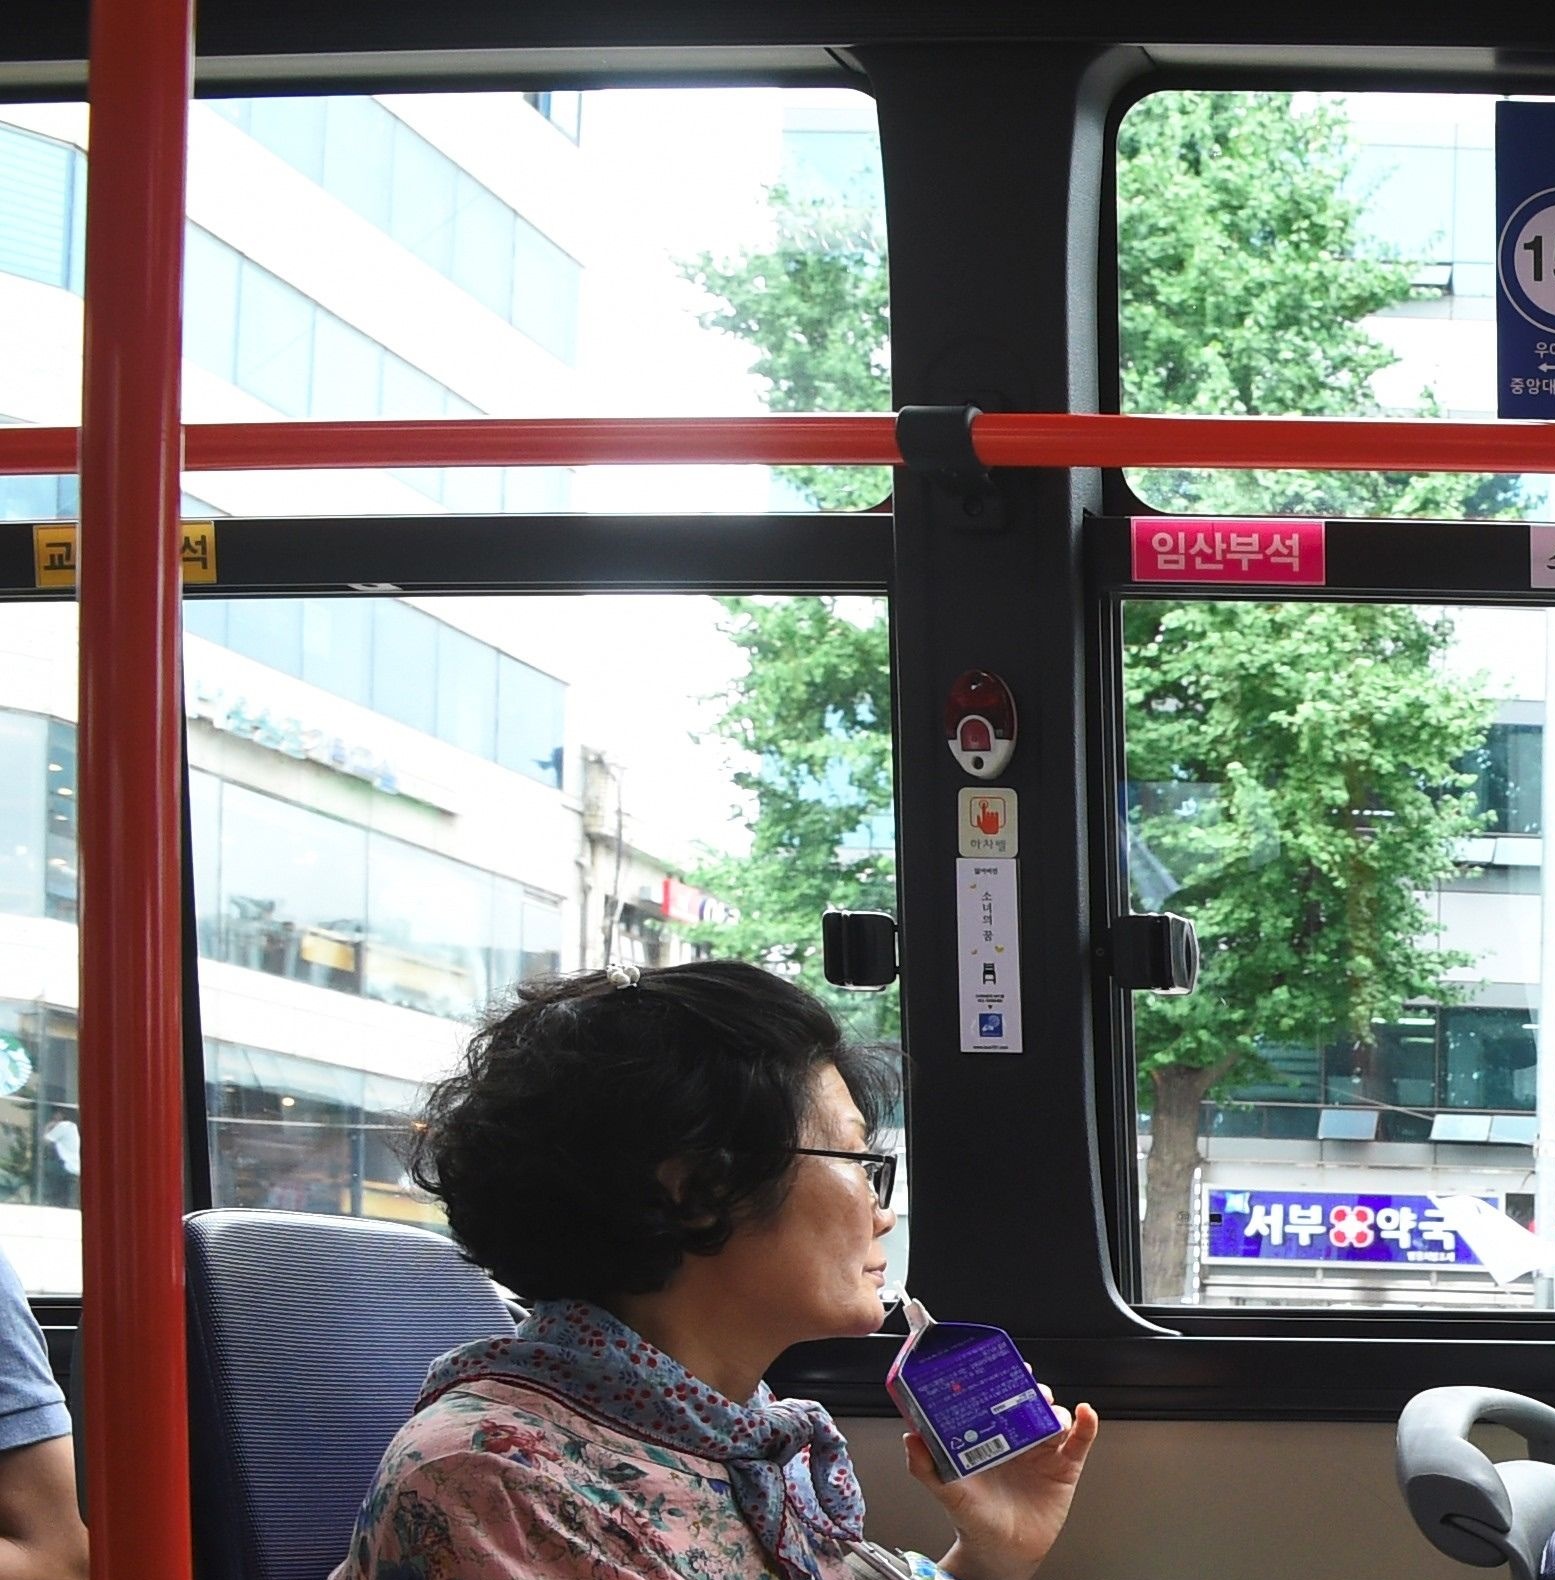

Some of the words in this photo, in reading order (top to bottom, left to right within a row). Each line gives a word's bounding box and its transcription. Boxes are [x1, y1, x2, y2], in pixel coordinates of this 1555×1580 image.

[1152, 532, 1299, 572] 임산부석
[970, 839, 1006, 852] 하차벨
[982, 892, 993, 926] 소녀의
[1244, 1204, 1327, 1246] 서부
[1376, 1207, 1456, 1250] 약국
